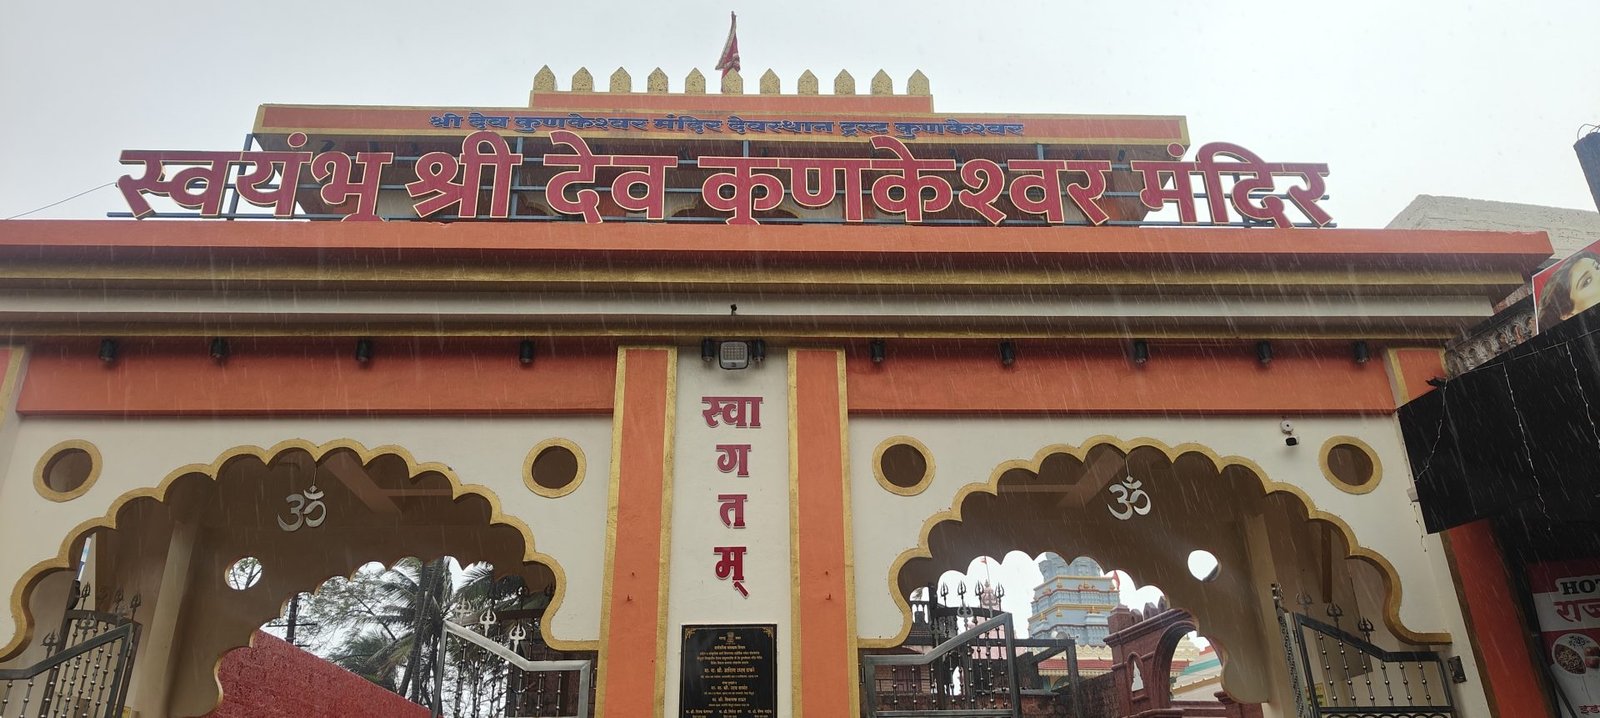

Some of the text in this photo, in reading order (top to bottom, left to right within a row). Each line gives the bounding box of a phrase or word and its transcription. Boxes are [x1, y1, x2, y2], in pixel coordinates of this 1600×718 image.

[429, 112, 1025, 140] श्री देव कुणकेश्वर मंदिर देवस्थान ट्रस्ट कुणकेश्वर
[404, 130, 523, 219] श्री
[543, 130, 679, 224] देव
[1130, 142, 1334, 229] मंदिर
